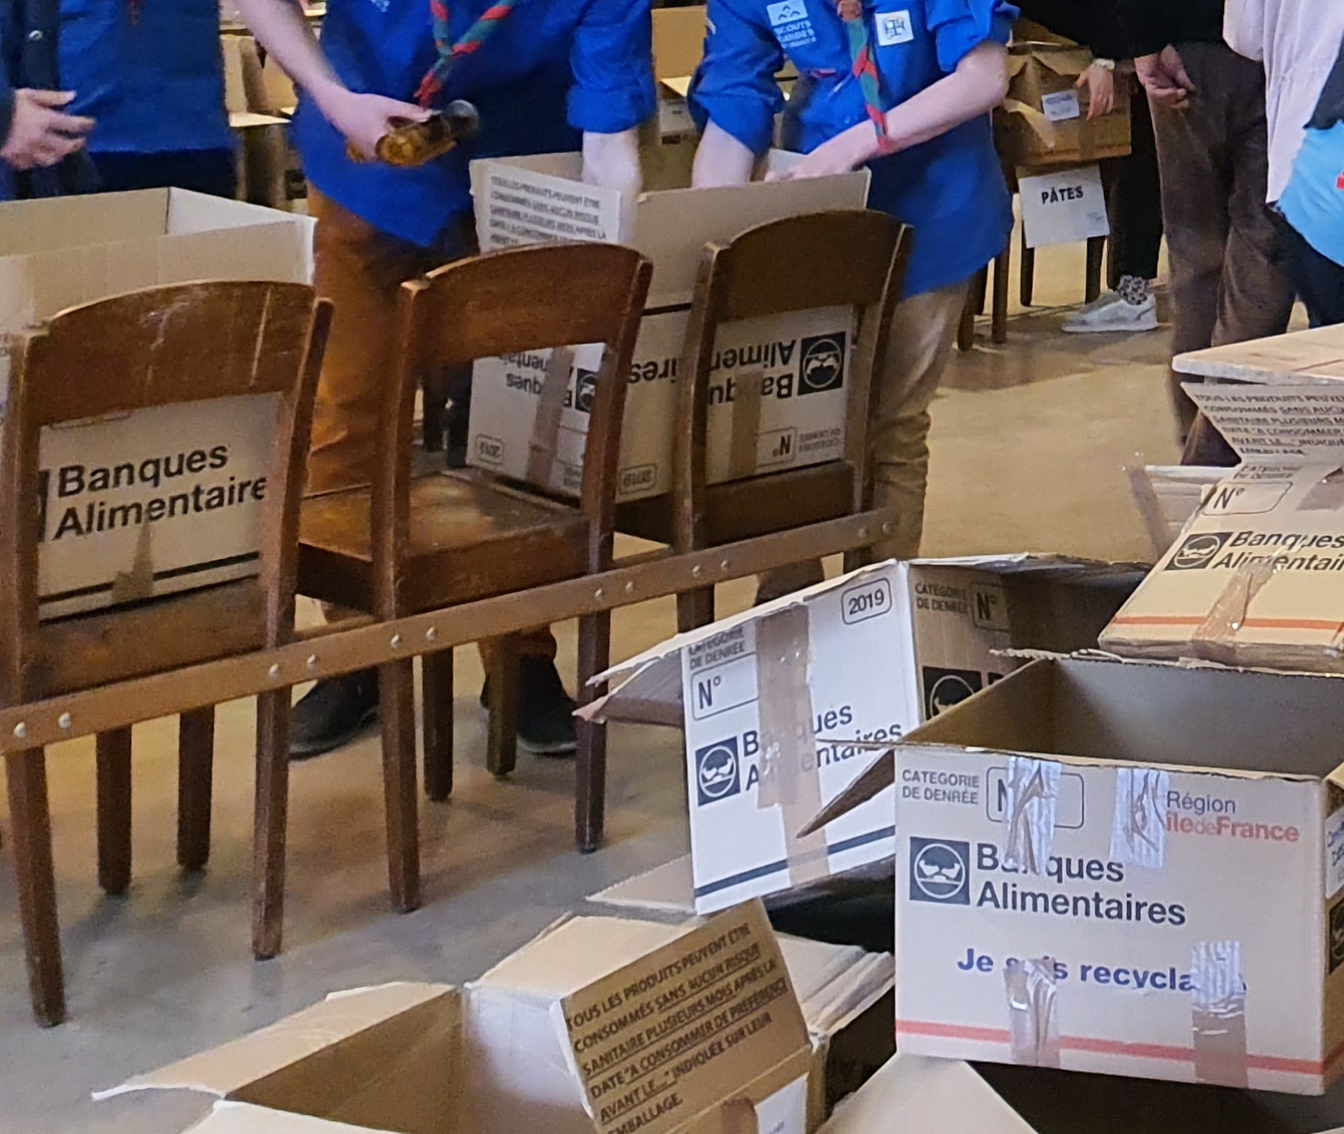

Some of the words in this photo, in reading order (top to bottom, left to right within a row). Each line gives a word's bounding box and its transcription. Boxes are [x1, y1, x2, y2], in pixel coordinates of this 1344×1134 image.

[1041, 186, 1084, 205] PÂTES
[772, 434, 791, 458] N°
[57, 444, 229, 498] Banques
[52, 476, 267, 541] Alimentaire
[1213, 488, 1245, 509] N°
[849, 588, 885, 616] 2019
[976, 592, 998, 621] N°
[690, 655, 703, 670] DE
[698, 675, 721, 710] N°
[902, 769, 980, 788] CATEGORIE
[1166, 790, 1236, 815] Région
[902, 786, 920, 800] DE
[977, 843, 1124, 883] Bques
[977, 881, 1187, 926] Alimentaires
[957, 948, 994, 974] Je
[566, 1005, 600, 1031] TOUS
[601, 991, 623, 1013] LES
[625, 962, 682, 1001] PRODUITS
[682, 936, 727, 971] PEUVENT
[657, 984, 686, 1010] SANS
[689, 961, 726, 991] AUCUN
[583, 1032, 644, 1077] SANITAIRE
[646, 997, 705, 1043] PLUSIEURS
[706, 987, 733, 1009] MOIS
[764, 959, 777, 974] LA
[640, 1023, 715, 1071] CONSOMMER
[715, 1011, 727, 1028] DE
[600, 1089, 642, 1123] AVANT
[726, 1029, 746, 1048] SUR
[748, 1012, 772, 1036] LEUR
